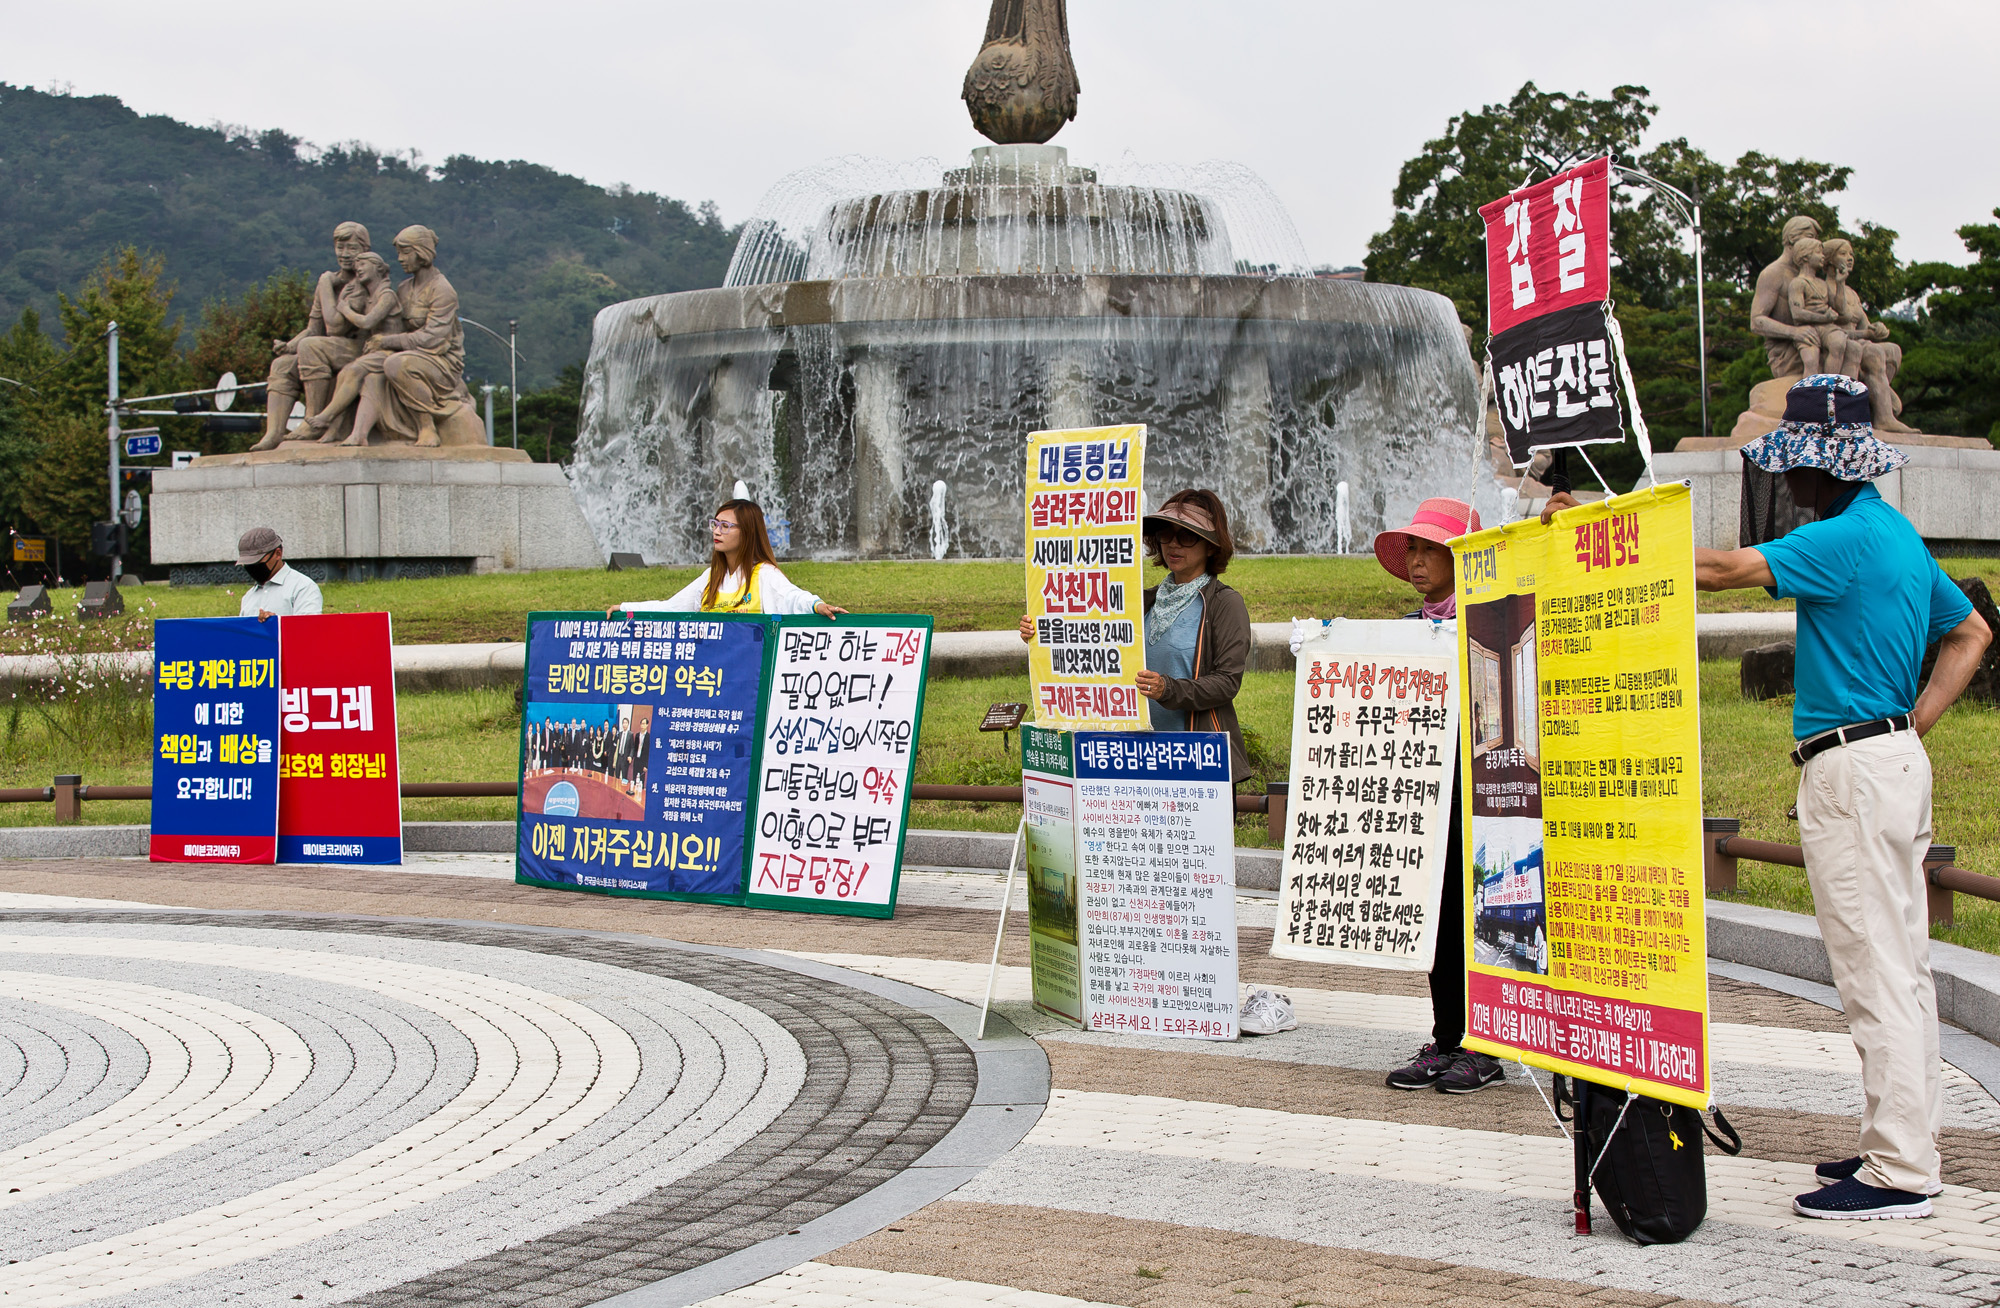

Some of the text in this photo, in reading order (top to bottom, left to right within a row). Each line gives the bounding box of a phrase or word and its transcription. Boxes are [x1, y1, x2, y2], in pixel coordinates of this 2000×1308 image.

[1040, 442, 1128, 482] 대통령님
[1032, 491, 1135, 526] 살려주세요!!
[1033, 538, 1133, 565] 사이비 사기집단
[1043, 572, 1123, 613] 신천지에
[554, 621, 724, 639] 1,000억 흑자 하이디스 공장폐쇄! 정리해고!
[569, 641, 696, 660] 대만 자본 기술 먹튀 중단을 위한
[785, 629, 921, 666] 말로만 하는 교섭
[1053, 649, 1120, 674] 빼앗겼어요
[159, 658, 274, 689] 부당 계약 파기
[548, 664, 722, 698] 문재인 대통령의 약속!
[1307, 662, 1448, 708] 충주시청 기업지원과
[281, 686, 373, 733] 빙그레
[1041, 686, 1137, 717] 구해주세요!!
[195, 702, 243, 725] 에 대한
[160, 734, 272, 763] 책임과 배상을
[330, 754, 386, 778] 회장님!
[177, 777, 252, 800] 요구합니다!
[765, 763, 898, 805] 대통령님의 약속
[1081, 785, 1110, 797] 단란했던
[1392, 776, 1440, 809] 송두리째
[1162, 802, 1199, 812] 가출했어요
[1083, 814, 1192, 827] 사이비신천지교주 이만희(87)는
[1083, 827, 1196, 840] 예수의 영을받아 육체가 죽지않고
[532, 822, 721, 872] 이젠 지켜주십시오!!
[1131, 843, 1146, 853] 속여
[1149, 843, 1163, 853] 이를
[1167, 844, 1188, 854] 믿으면
[1292, 842, 1423, 870] 지경에 이르게 했습니다
[1085, 855, 1207, 869] 또한 죽지않는다고 세뇌되어 집니다.
[758, 853, 869, 897] 지금당장!
[1085, 869, 1190, 882] 그로인해 현재 많은 젊은이들이
[1086, 883, 1213, 898] 직장포기 가족과의 관계단절로 세상엔
[1086, 896, 1108, 907] 관심이
[1112, 898, 1126, 908] 없고
[1087, 910, 1206, 926] 이만희(87세)의 인생앵벌이가 되고
[1166, 928, 1221, 941] 이혼을 조장하고
[1317, 923, 1334, 946] 믿고
[1339, 924, 1371, 950] 살아야
[1088, 938, 1230, 957] 자녀로인해 괴로움을 견디다못해 자살하는
[1089, 952, 1145, 965] 사람도 있습니다.
[1090, 966, 1125, 977] 이런문제가
[1129, 968, 1165, 980] 가정파탄에
[1168, 971, 1190, 982] 이르러
[1194, 973, 1216, 983] 사회의
[1090, 980, 1111, 990] 문제를
[1115, 981, 1129, 992] 낳고
[1132, 982, 1154, 993] 국가의
[1158, 984, 1179, 995] 재앙이
[1091, 993, 1104, 1004] 이런
[1108, 995, 1158, 1008] 사이비신천지를
